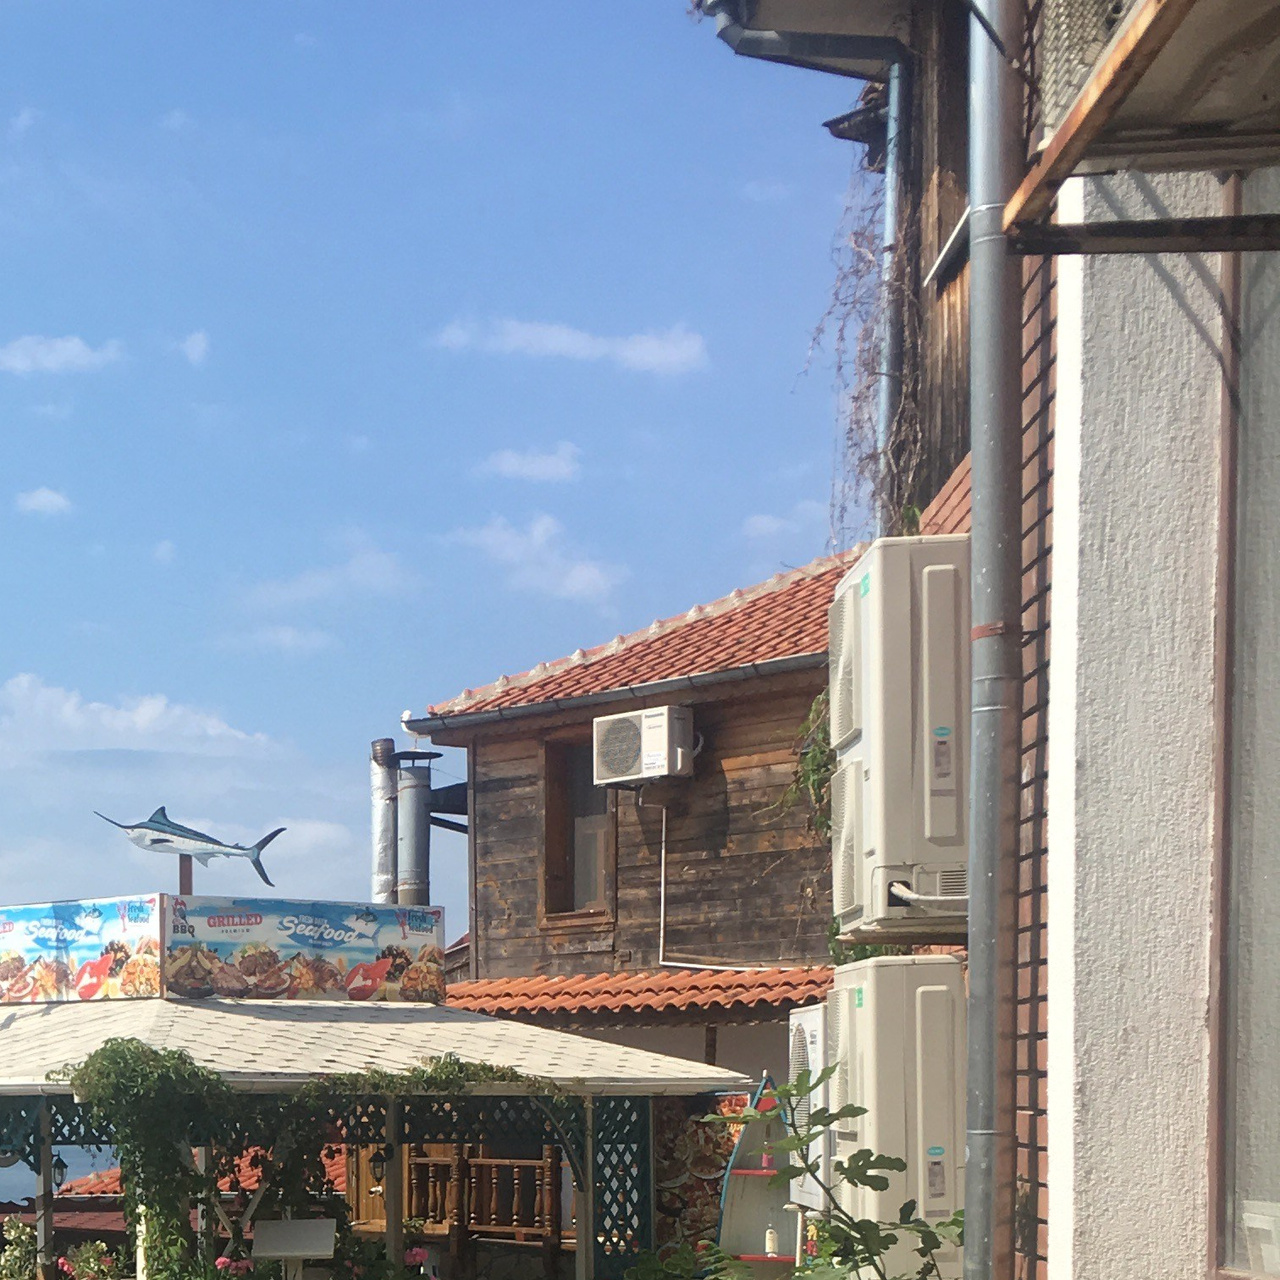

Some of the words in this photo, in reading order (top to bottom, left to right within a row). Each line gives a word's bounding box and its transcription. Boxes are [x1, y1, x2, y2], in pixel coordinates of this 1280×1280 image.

[207, 913, 263, 928] GRILLED
[277, 915, 360, 942] Seafood
[24, 920, 87, 941] Seafood
[172, 925, 195, 938] BBQ
